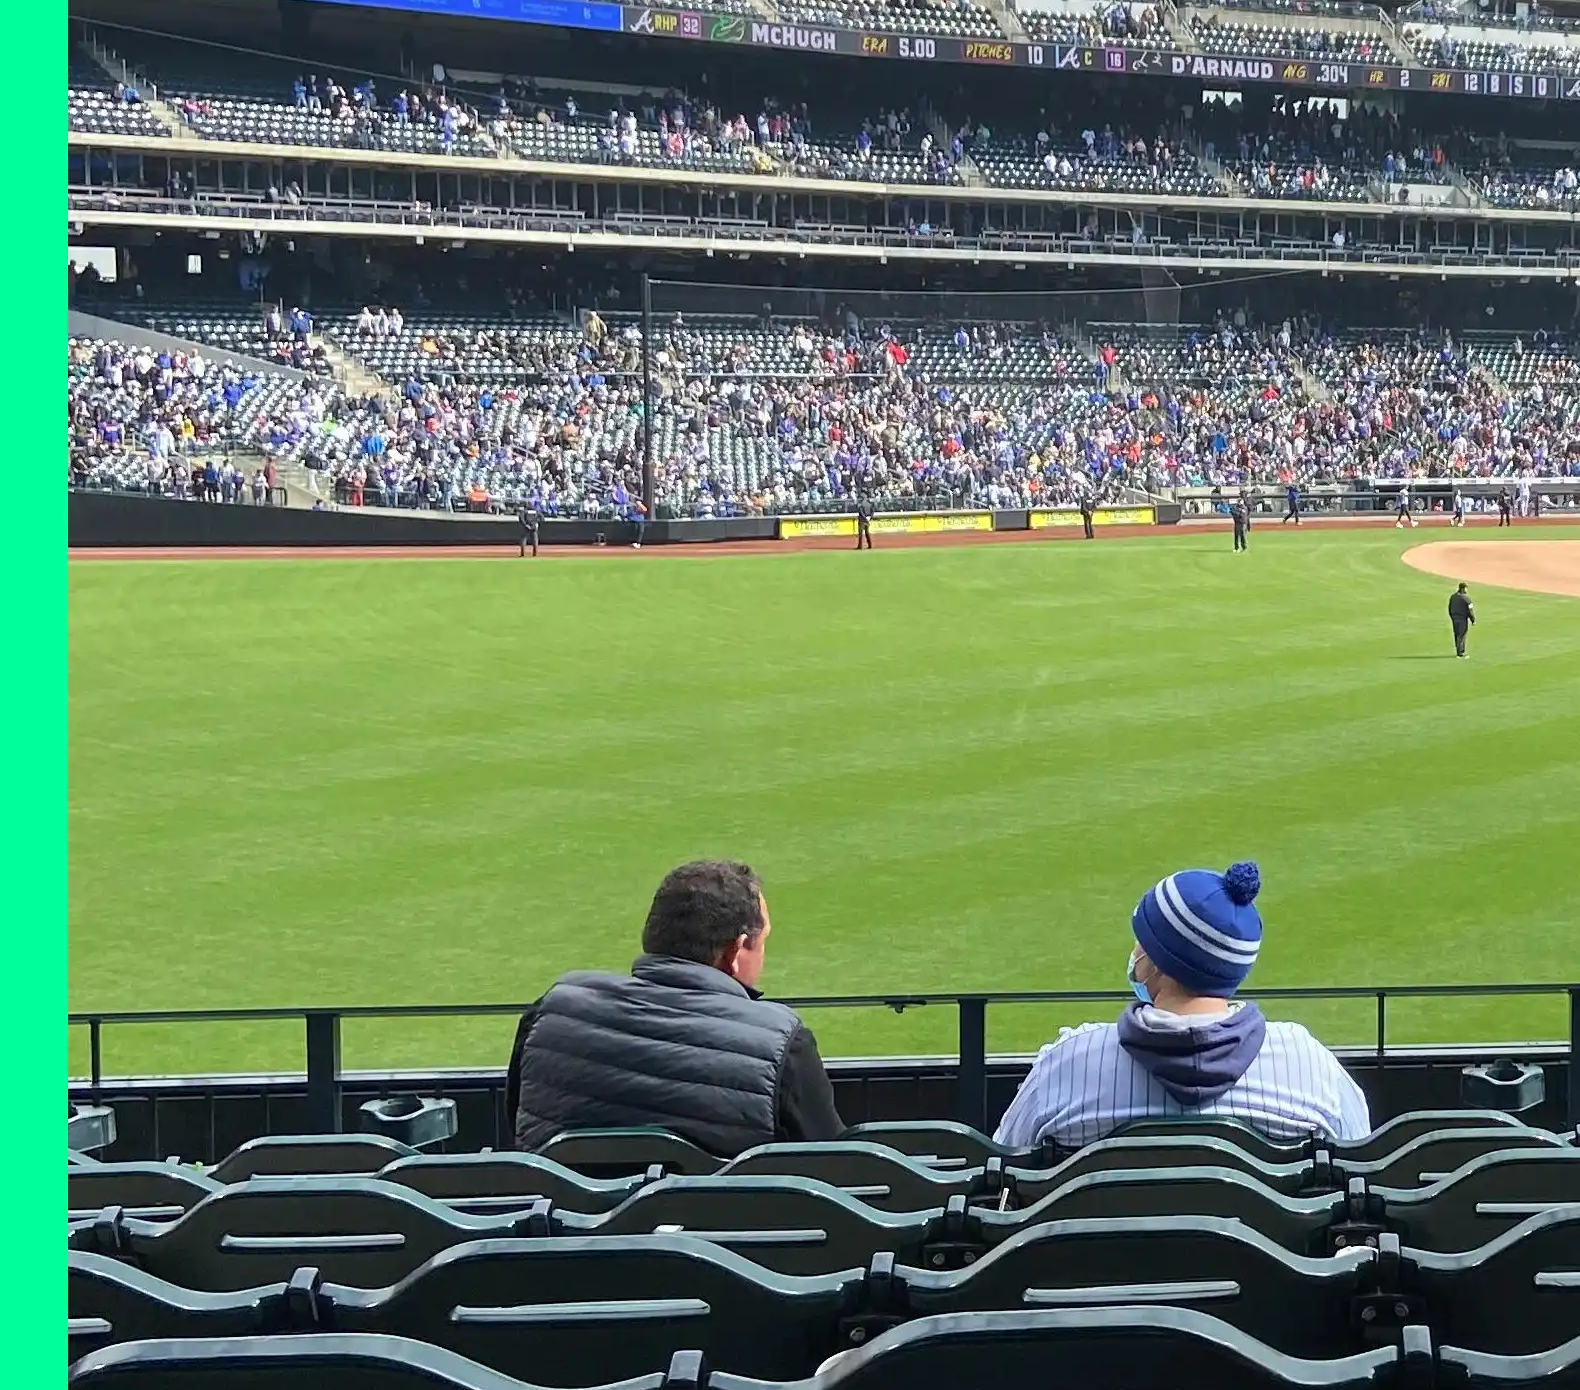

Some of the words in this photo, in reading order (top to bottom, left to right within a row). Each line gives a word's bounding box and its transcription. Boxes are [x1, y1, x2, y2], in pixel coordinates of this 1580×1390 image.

[654, 14, 677, 32] RHP
[683, 17, 699, 33] 32
[861, 37, 888, 53] ERA
[899, 38, 936, 59] 5.00
[965, 43, 1012, 60] PITCHES
[1028, 45, 1044, 64] 10
[1084, 51, 1092, 66] C
[1171, 55, 1274, 78] D'ARNAUD
[1316, 65, 1349, 84] .304
[1369, 70, 1384, 84] HR
[1400, 71, 1410, 87] 2
[1431, 74, 1451, 88] RBI
[1464, 73, 1478, 91] 12
[1514, 76, 1524, 94] S
